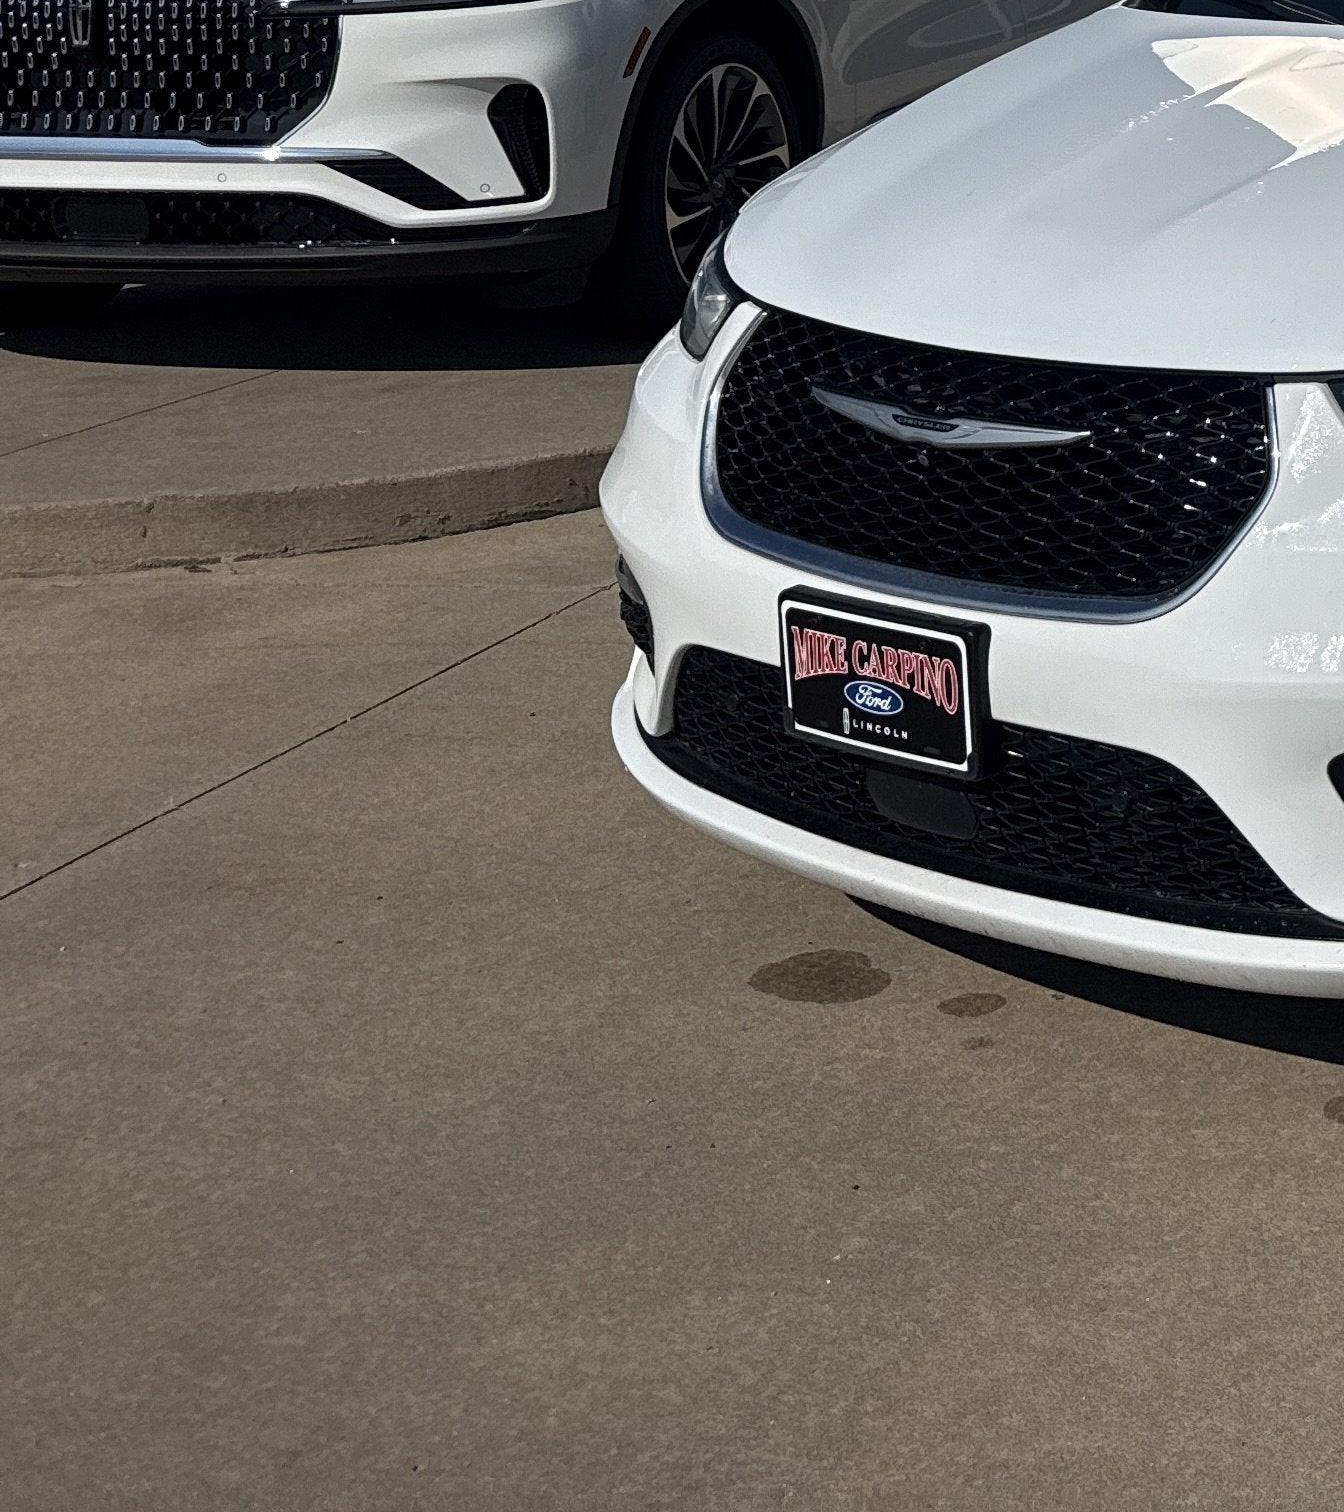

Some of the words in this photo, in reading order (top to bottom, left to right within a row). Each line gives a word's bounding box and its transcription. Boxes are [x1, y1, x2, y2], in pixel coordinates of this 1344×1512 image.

[896, 417, 951, 431] CHRYSLER
[791, 626, 848, 680] MIKE
[852, 640, 958, 714] CARPINO
[855, 684, 892, 711] Ford
[853, 719, 908, 739] LINCOLN
